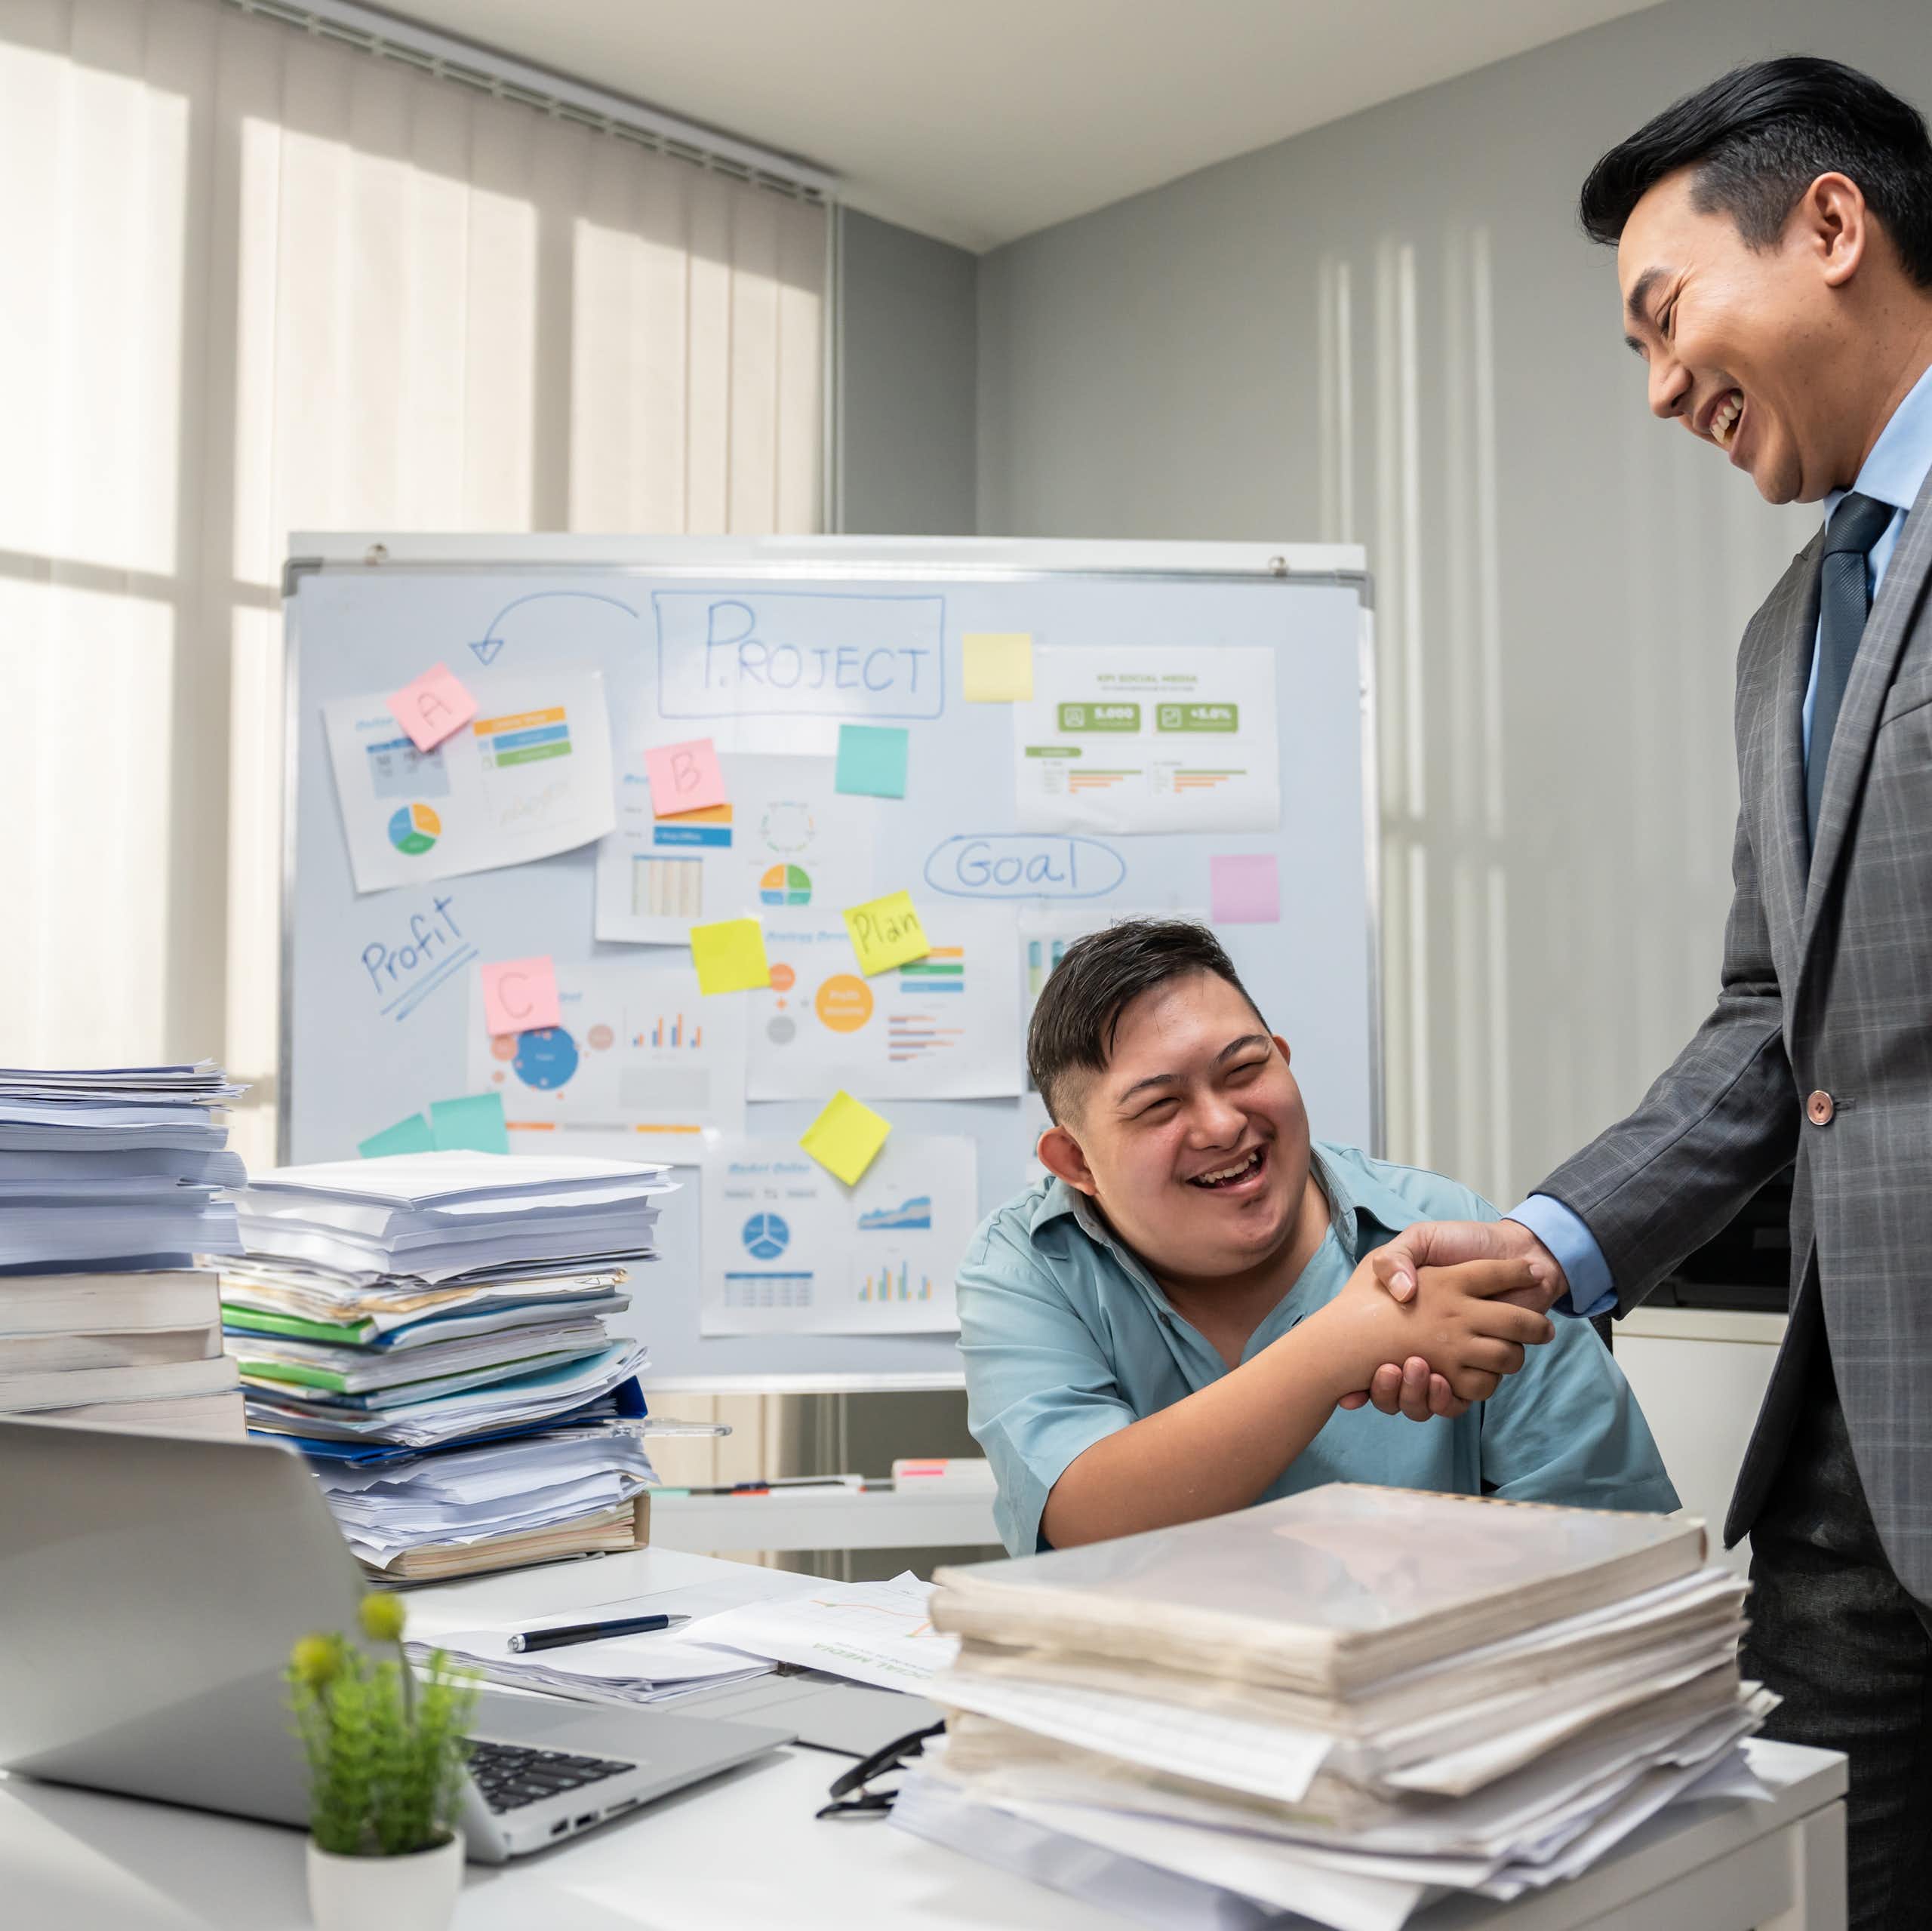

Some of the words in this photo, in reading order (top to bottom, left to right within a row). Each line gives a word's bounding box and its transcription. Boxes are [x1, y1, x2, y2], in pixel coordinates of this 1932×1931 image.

[417, 692, 453, 728] A
[669, 751, 701, 793] B
[956, 840, 1078, 888] Goal
[361, 896, 463, 994] Profit
[852, 911, 920, 955] Plan
[497, 970, 534, 1019] C
